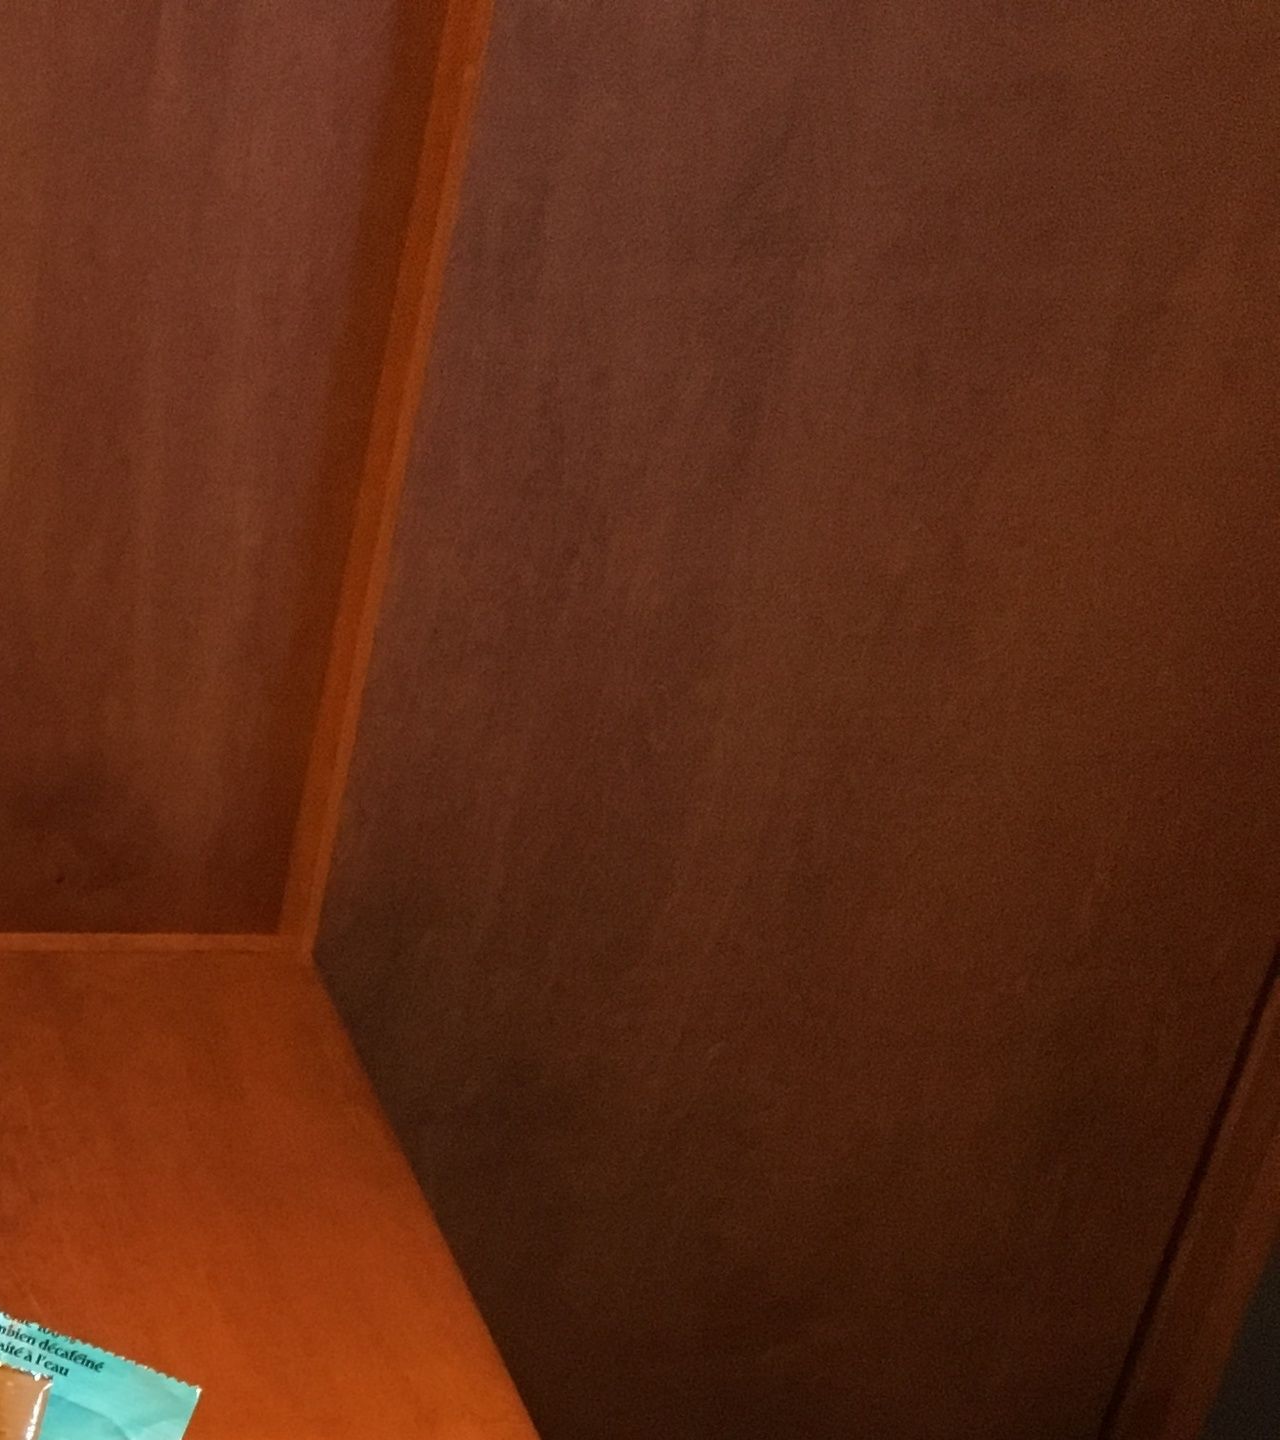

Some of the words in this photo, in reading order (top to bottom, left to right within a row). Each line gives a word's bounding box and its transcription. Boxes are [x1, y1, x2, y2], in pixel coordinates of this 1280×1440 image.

[22, 1349, 33, 1363] à
[35, 1354, 70, 1377] l'eau
[38, 1338, 105, 1373] décaféiné
